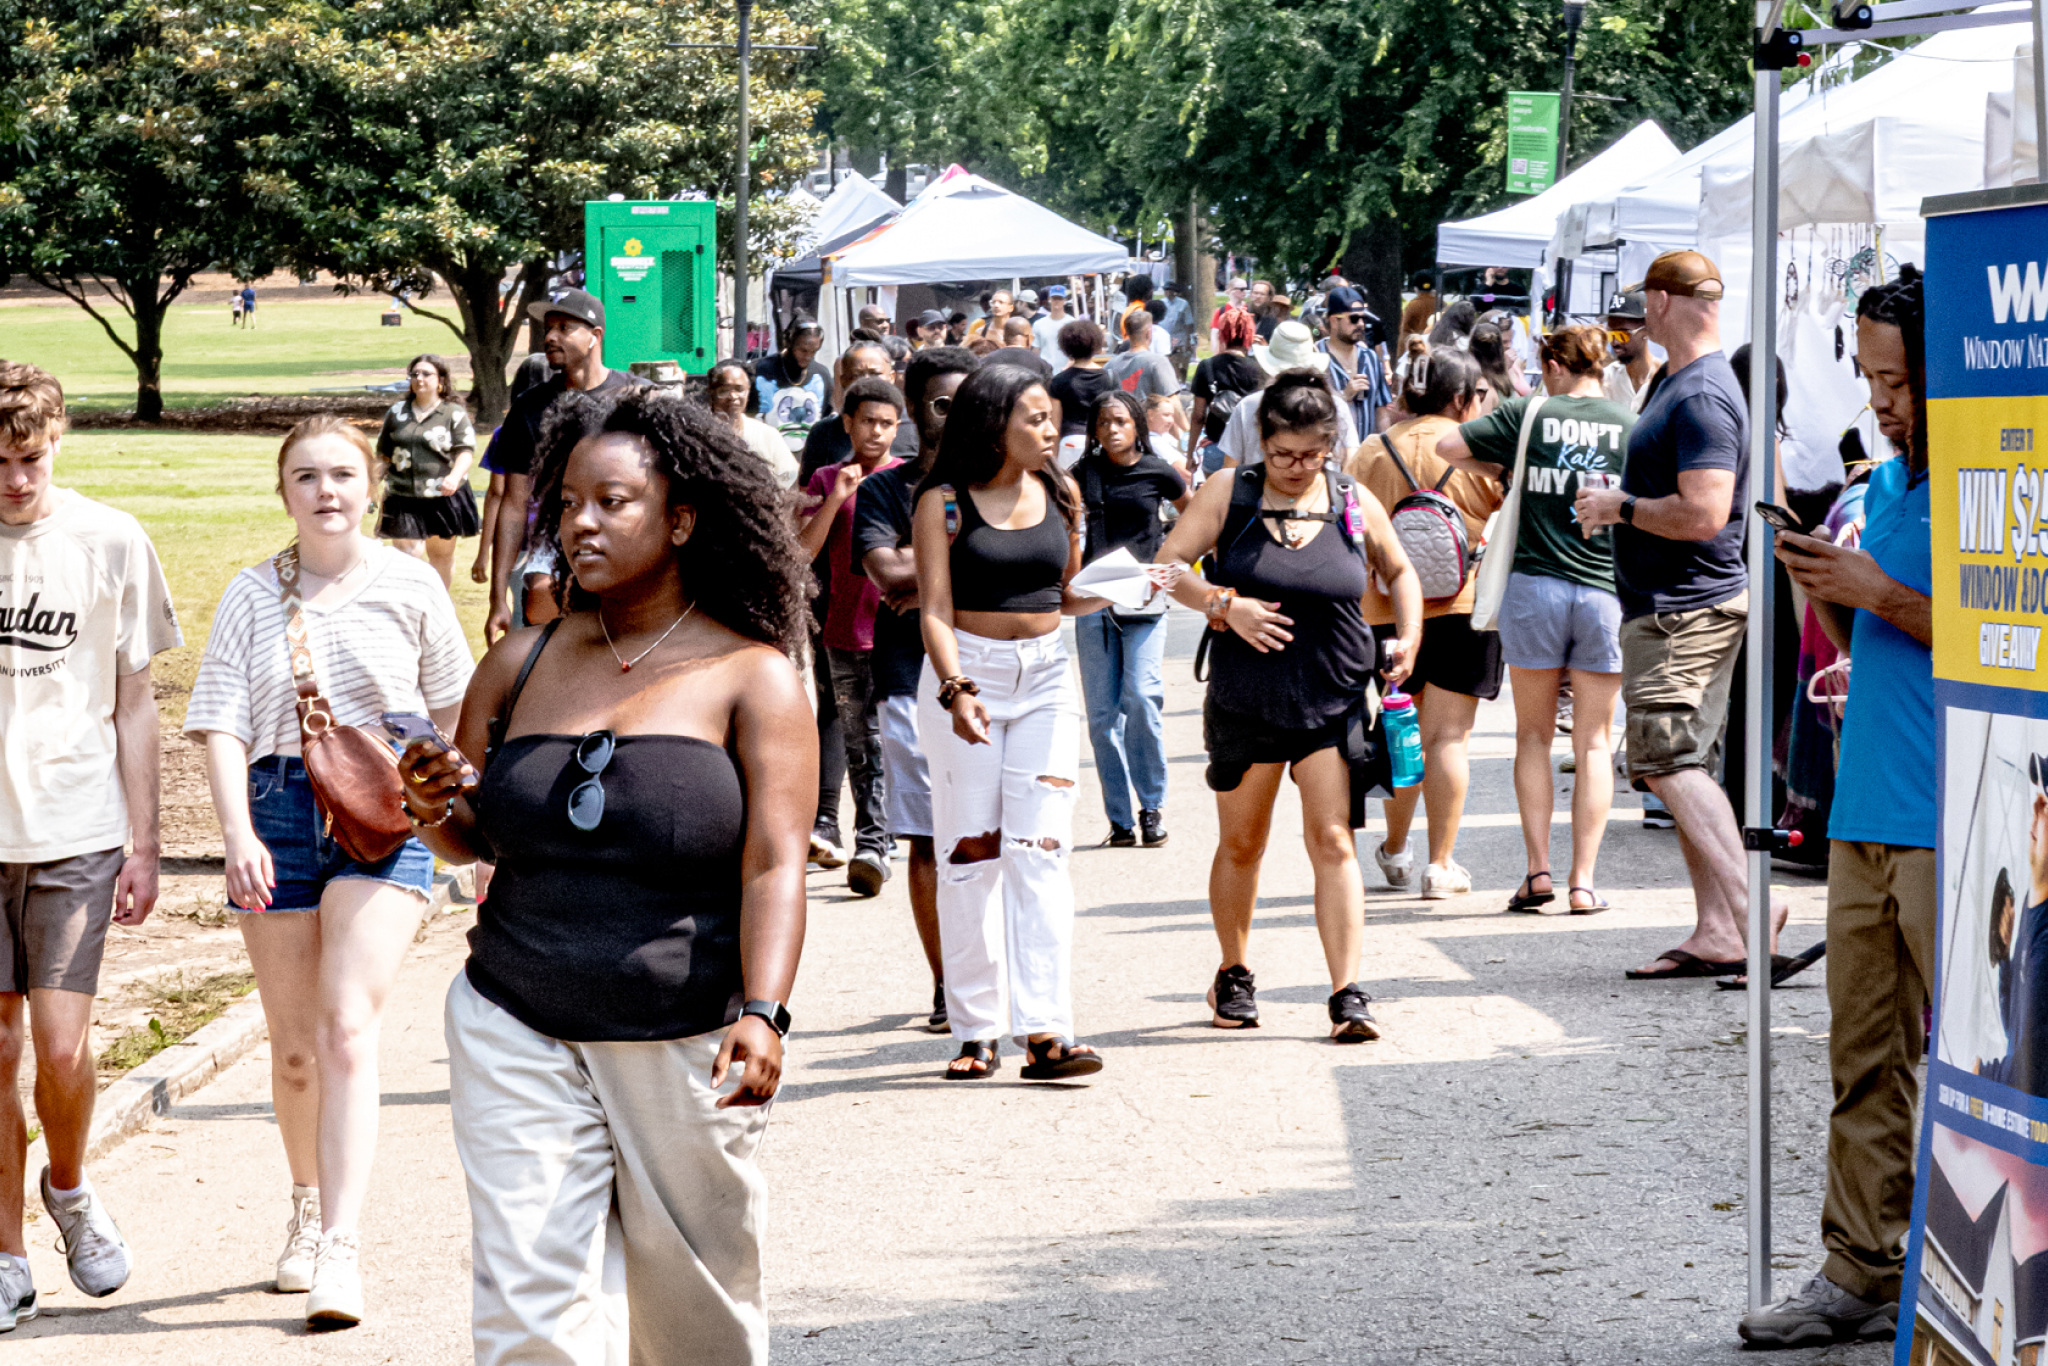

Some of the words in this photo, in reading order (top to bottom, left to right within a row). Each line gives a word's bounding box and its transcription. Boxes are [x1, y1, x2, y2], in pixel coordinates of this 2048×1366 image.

[1963, 335, 2025, 370] WINDOW
[1542, 417, 1623, 450] DON'T
[1557, 441, 1609, 471] Kale
[1528, 466, 1570, 495] MY
[1958, 467, 2007, 554] WIN
[25, 574, 44, 584] 1905
[1960, 564, 2019, 612] WINDOW
[0, 591, 77, 636] udan
